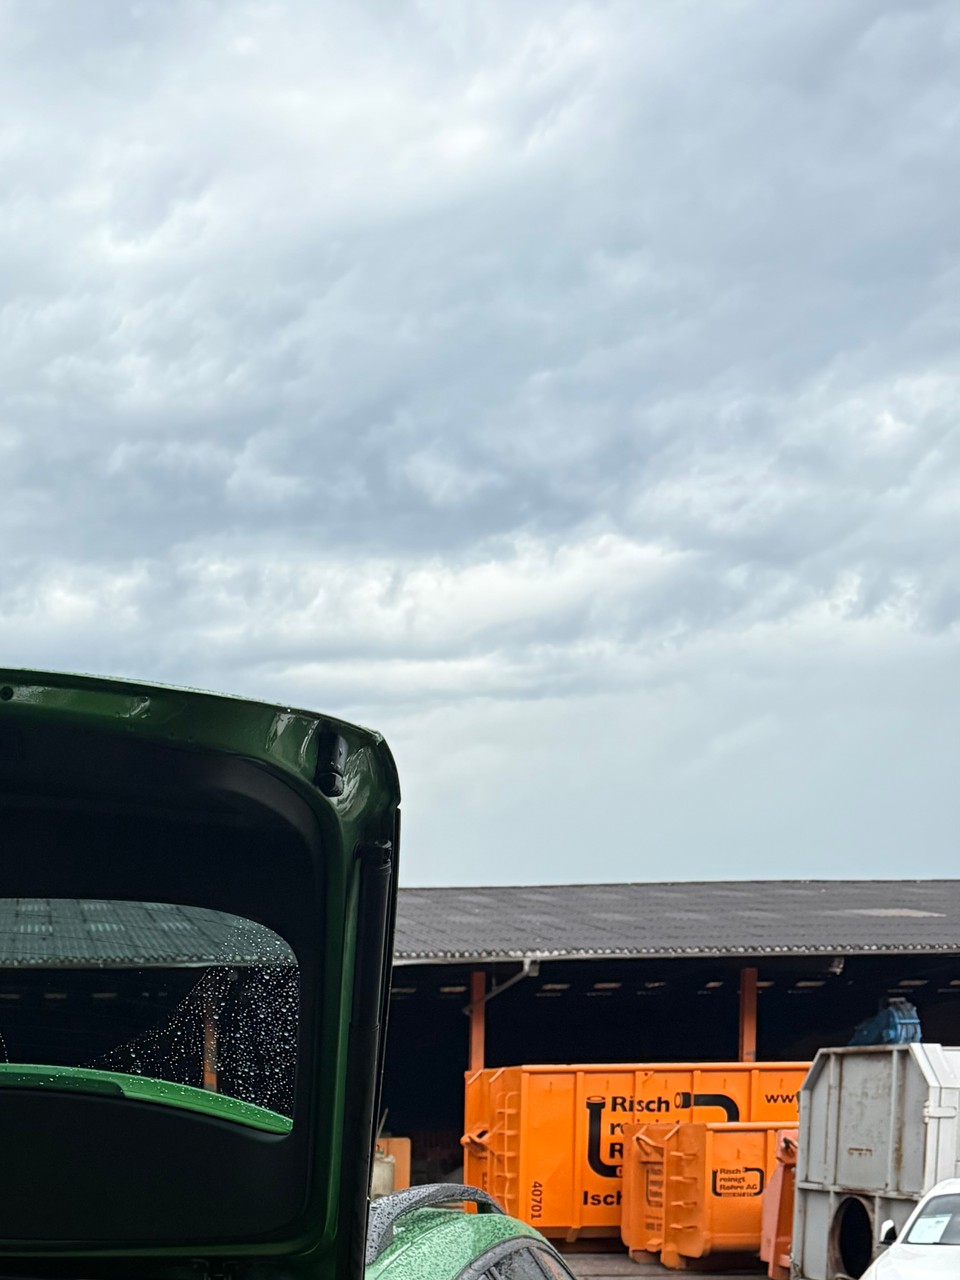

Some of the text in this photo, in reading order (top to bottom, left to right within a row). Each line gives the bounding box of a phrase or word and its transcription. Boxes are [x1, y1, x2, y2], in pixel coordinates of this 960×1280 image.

[611, 1095, 670, 1112] Risch
[746, 1183, 758, 1191] AG
[530, 1180, 543, 1220] 40701
